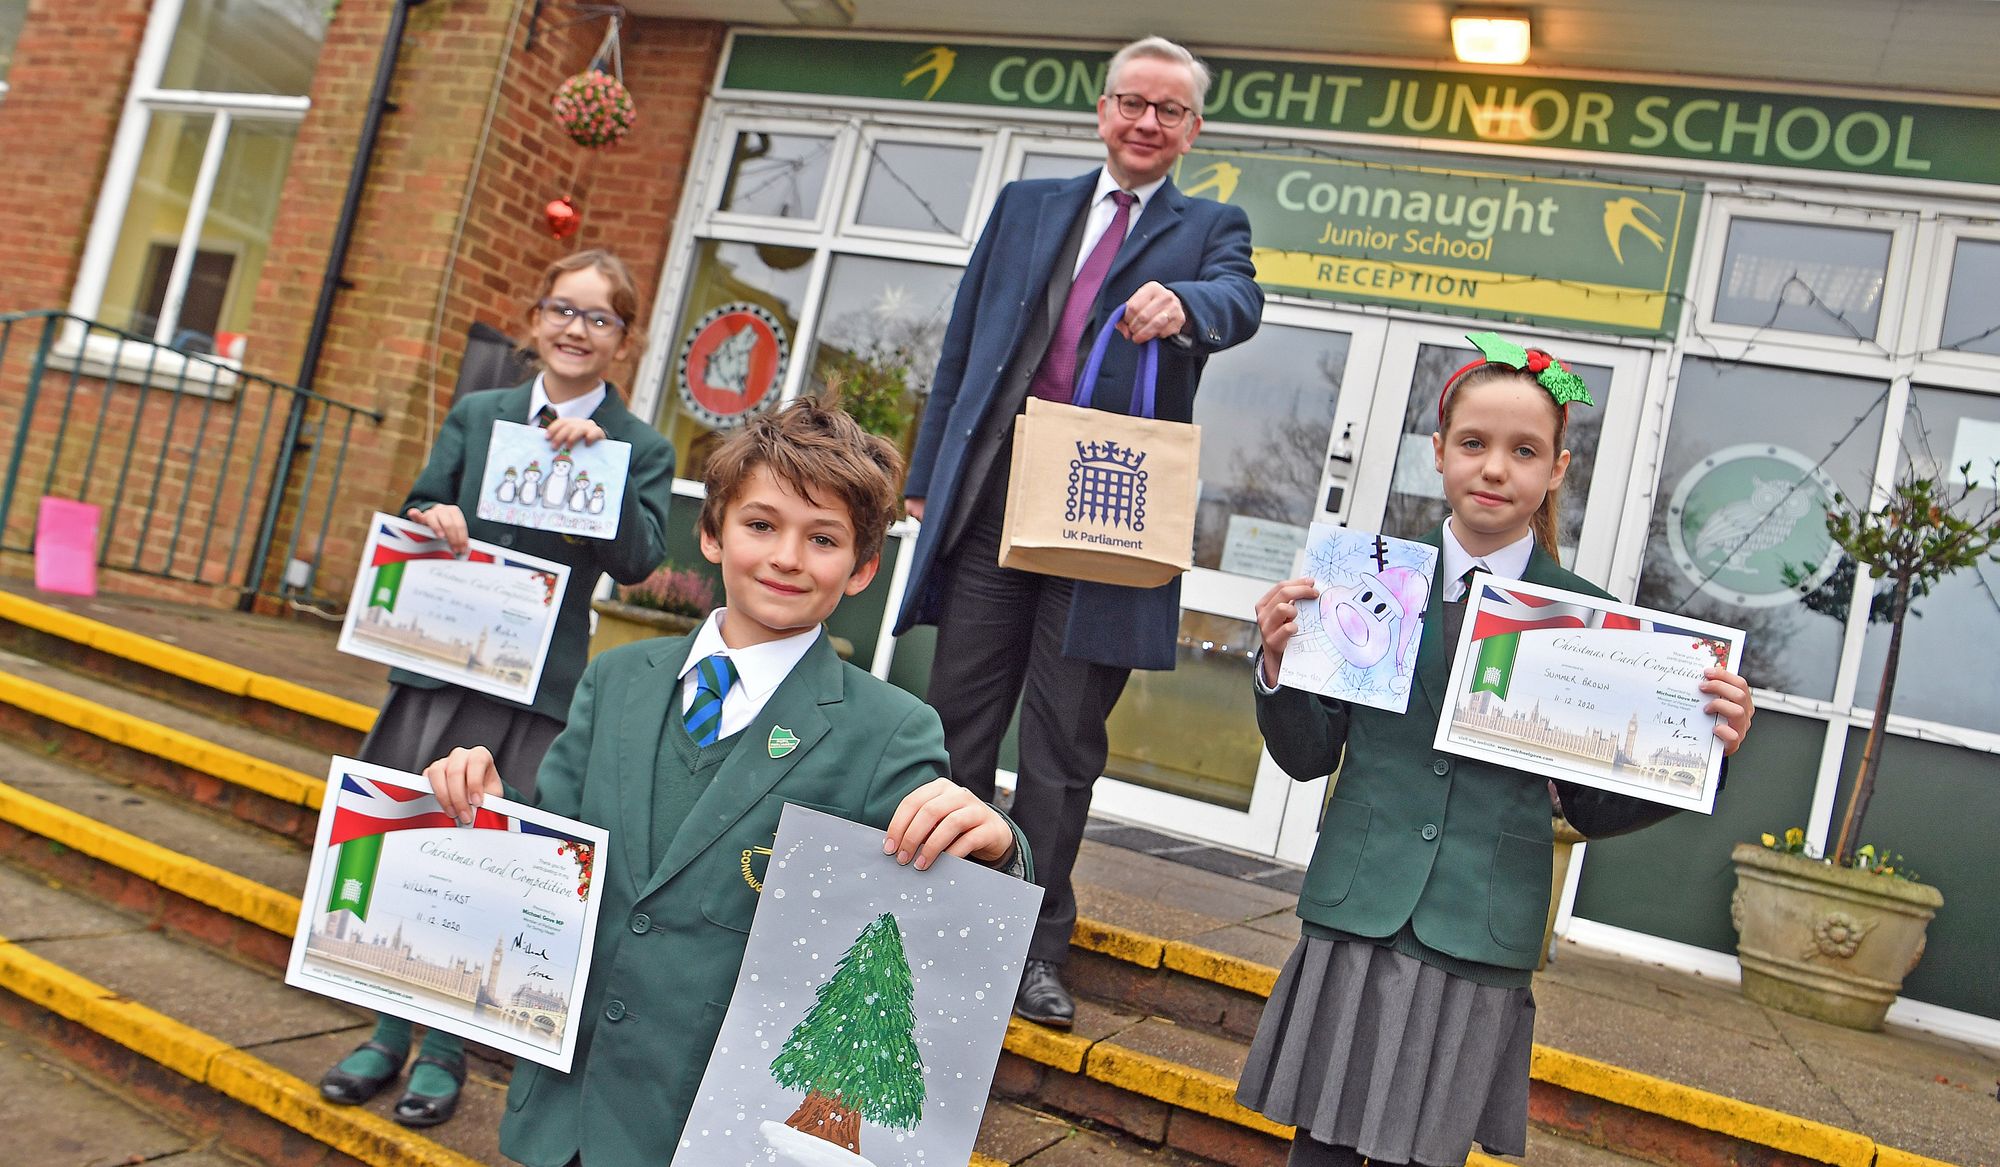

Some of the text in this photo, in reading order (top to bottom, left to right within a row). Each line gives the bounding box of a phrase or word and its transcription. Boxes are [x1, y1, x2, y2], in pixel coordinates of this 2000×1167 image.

[988, 56, 1931, 172] CONUGHT JUNIOR SCHOOL
[1276, 170, 1559, 240] Connaught
[1318, 222, 1493, 261] Junior School
[1317, 263, 1478, 298] RECEPTION
[1062, 528, 1143, 550] UK Parliament
[1552, 635, 1605, 659] Christmas
[1610, 650, 1650, 668] Card
[1544, 668, 1610, 690] SUMMER BROWN
[420, 838, 475, 866] Christmas
[479, 857, 517, 878] Card
[511, 867, 573, 898] Competition
[741, 849, 764, 892] CONNAUG
[402, 881, 472, 905] WILLIAM FURST
